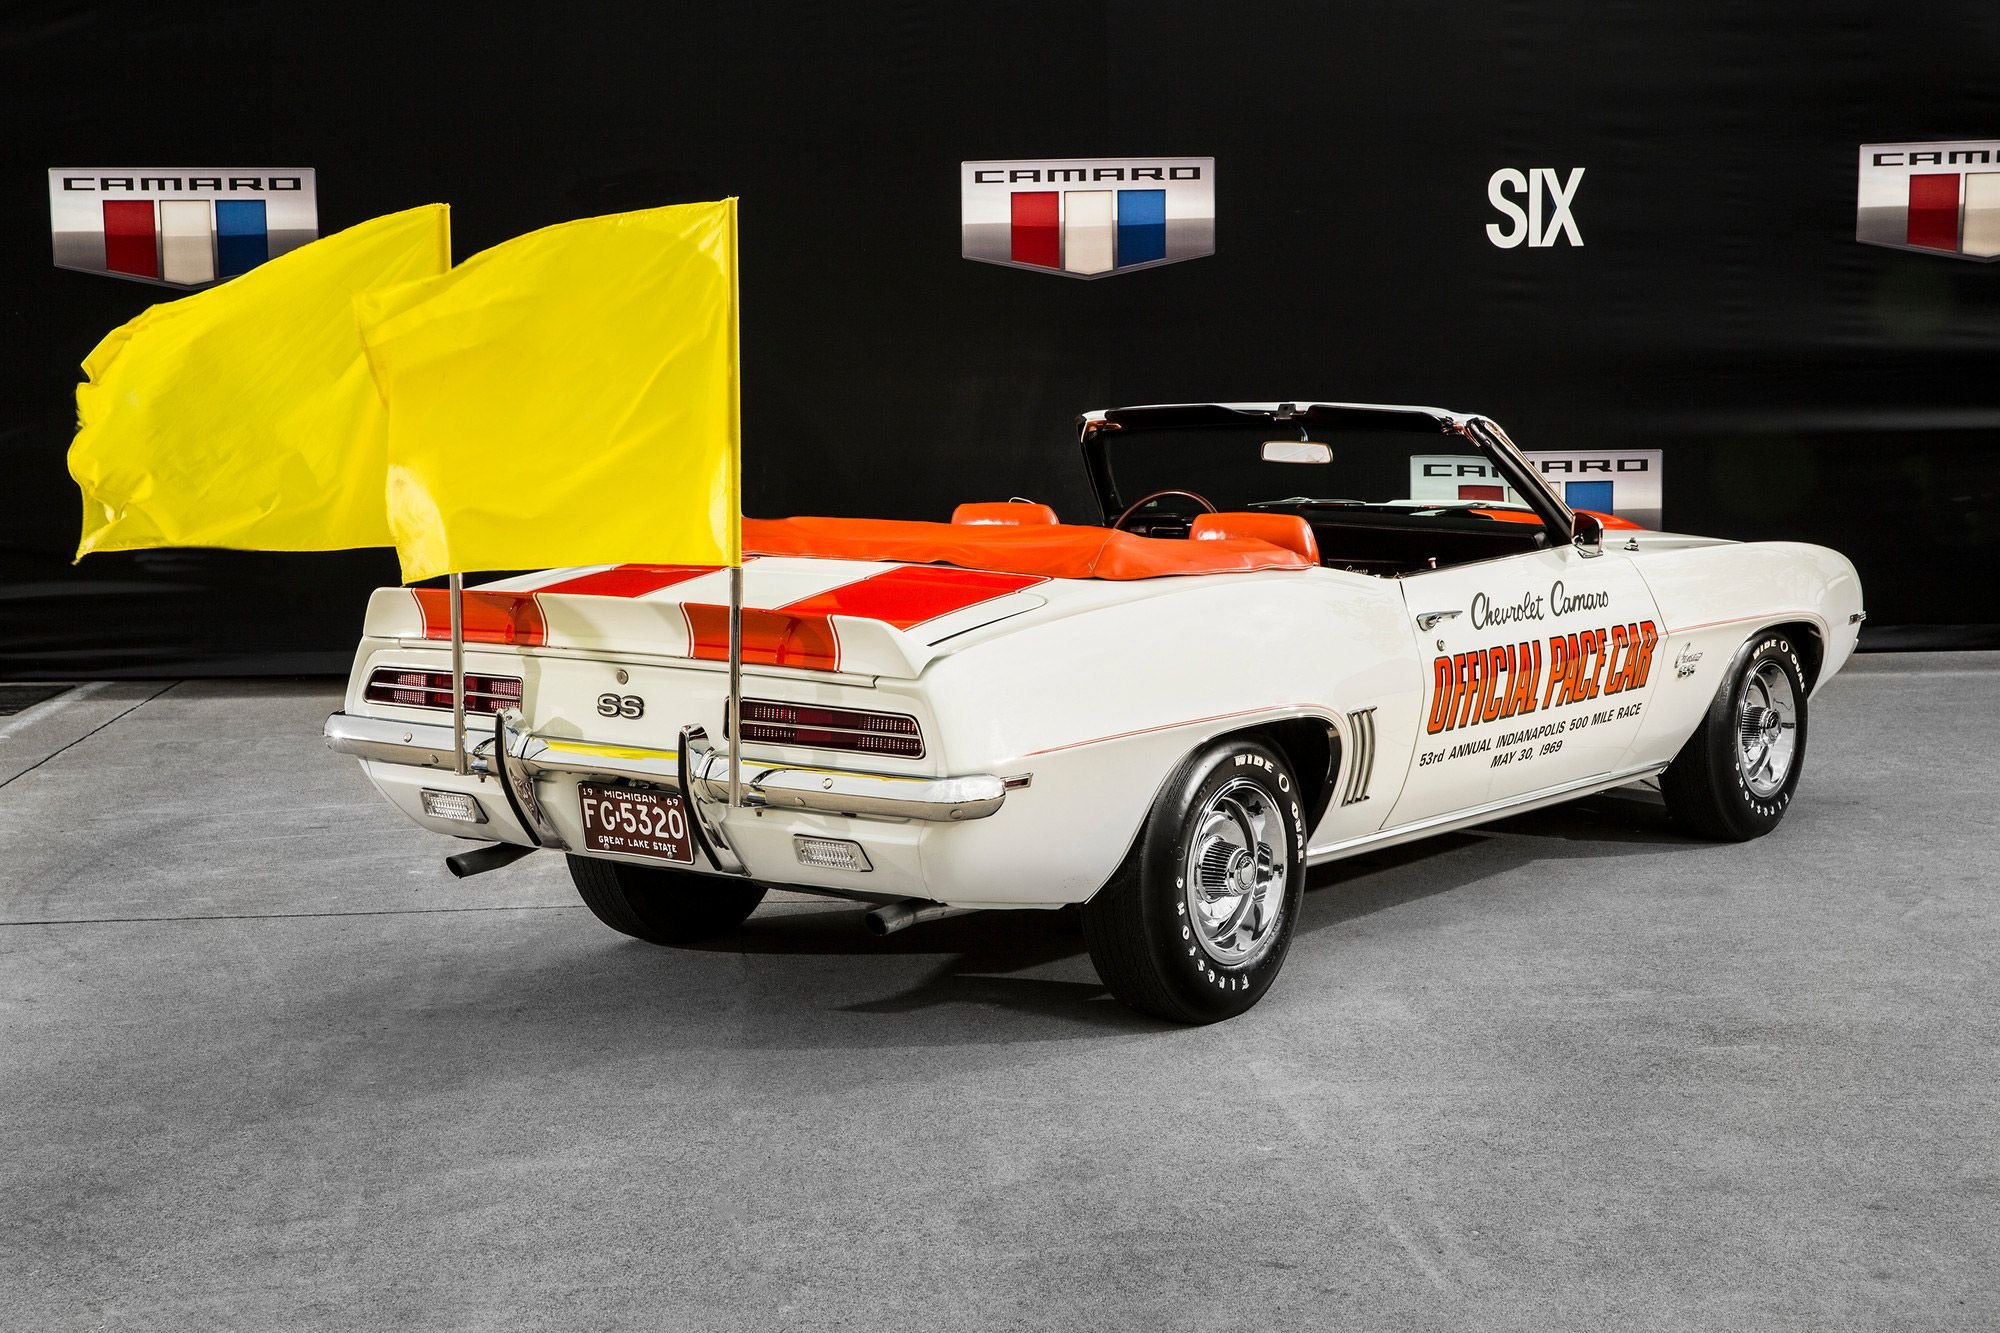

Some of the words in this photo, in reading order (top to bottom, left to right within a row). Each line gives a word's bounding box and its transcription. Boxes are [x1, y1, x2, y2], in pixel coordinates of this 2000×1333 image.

[1873, 150, 2000, 166] CAM
[62, 177, 302, 191] CAMARO
[974, 167, 1201, 184] CAMARO
[1485, 167, 1586, 249] SIX
[1471, 591, 1545, 630] Chevrolet
[1550, 580, 1609, 617] Camaro
[1753, 639, 1777, 660] WIDE
[1427, 639, 1542, 735] OFFICIAL
[1542, 628, 1607, 710] PACE
[1604, 620, 1659, 695] CAR
[597, 693, 644, 720] SS
[1419, 749, 1445, 767] 53rd
[1448, 736, 1492, 760] ANNUAL
[1496, 721, 1567, 749] INDIANAPOLIS
[1569, 715, 1589, 732] 500
[1591, 710, 1614, 727] MILE
[1616, 702, 1643, 721] RACE
[1490, 752, 1515, 768] MAY
[1518, 747, 1534, 763] 30,
[1539, 740, 1563, 757] 1969
[604, 790, 657, 804] MICHIGAN
[666, 798, 679, 806] 69
[1234, 754, 1274, 773] WIDE
[1291, 801, 1304, 863] OVAL
[598, 835, 624, 846] GREAT
[628, 838, 650, 849] LAKE
[652, 842, 677, 853] STATE
